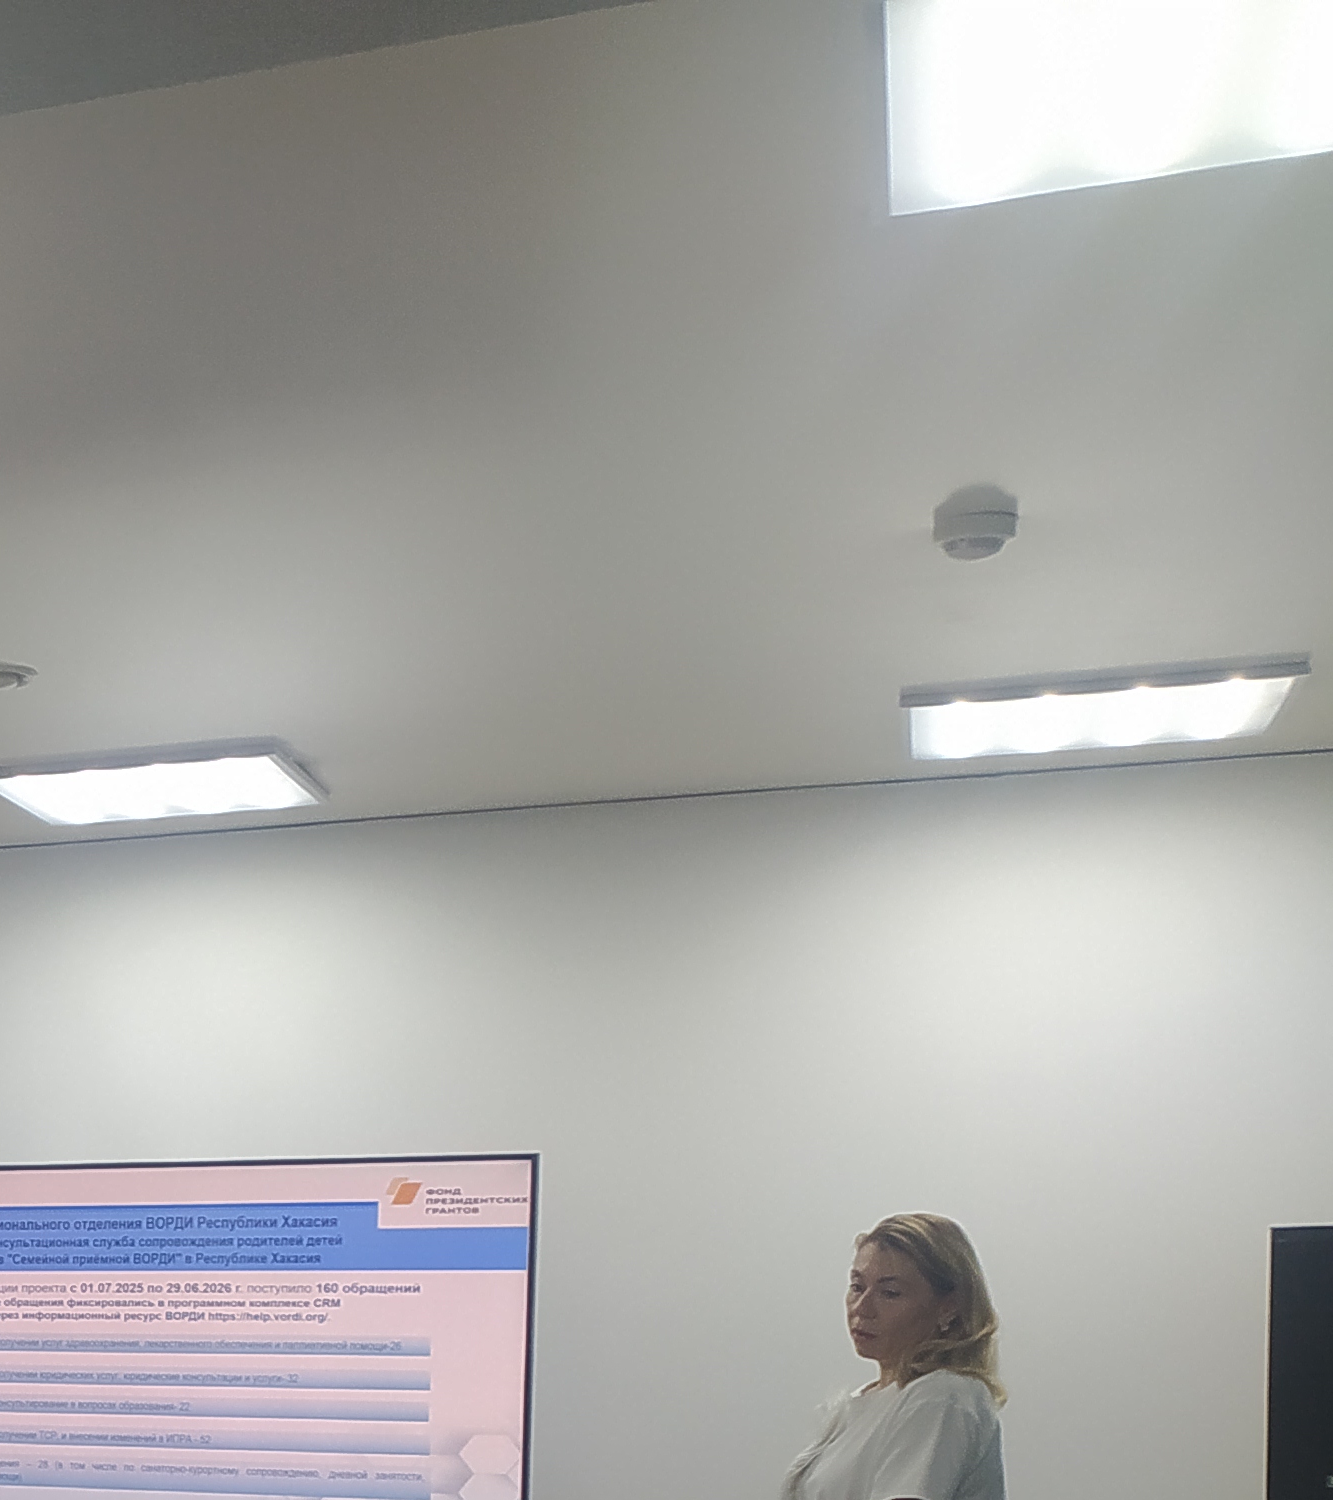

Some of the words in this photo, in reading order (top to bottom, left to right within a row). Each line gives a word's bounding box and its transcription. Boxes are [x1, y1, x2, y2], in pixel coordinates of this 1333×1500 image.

[425, 1188, 462, 1196] ФОНД
[425, 1196, 529, 1205] ПРЕЗИДЕНТСКИХ
[425, 1207, 480, 1215] ГРАНТОВ
[73, 1218, 142, 1231] отделения
[145, 1217, 194, 1232] ВОРДИ
[197, 1216, 278, 1230] Республики
[281, 1216, 338, 1228] Хакасия
[92, 1236, 136, 1250] служба
[138, 1237, 234, 1248] сопровождения
[237, 1235, 304, 1248] родителей
[306, 1235, 343, 1248] детей
[7, 1253, 69, 1265] "Семейной
[72, 1253, 130, 1267] приёмной
[134, 1253, 182, 1266] ВОРДИ"
[185, 1255, 192, 1264] в
[195, 1253, 267, 1266] Республике
[270, 1252, 321, 1264] Хакасия
[21, 1284, 67, 1295] проекта
[70, 1284, 77, 1293] с
[80, 1283, 144, 1293] 01.07.2025
[147, 1284, 163, 1293] по
[166, 1283, 232, 1293] 29.06.2026
[247, 1284, 312, 1295] поступило
[316, 1283, 339, 1293] 160
[342, 1282, 421, 1295] обращений
[3, 1297, 64, 1308] обращения
[67, 1298, 154, 1309] фиксировались
[168, 1300, 246, 1309] программном
[249, 1300, 310, 1308] комплексе
[22, 1311, 121, 1322] информационный
[124, 1312, 162, 1322] ресурс
[165, 1312, 205, 1322] ВОРДИ
